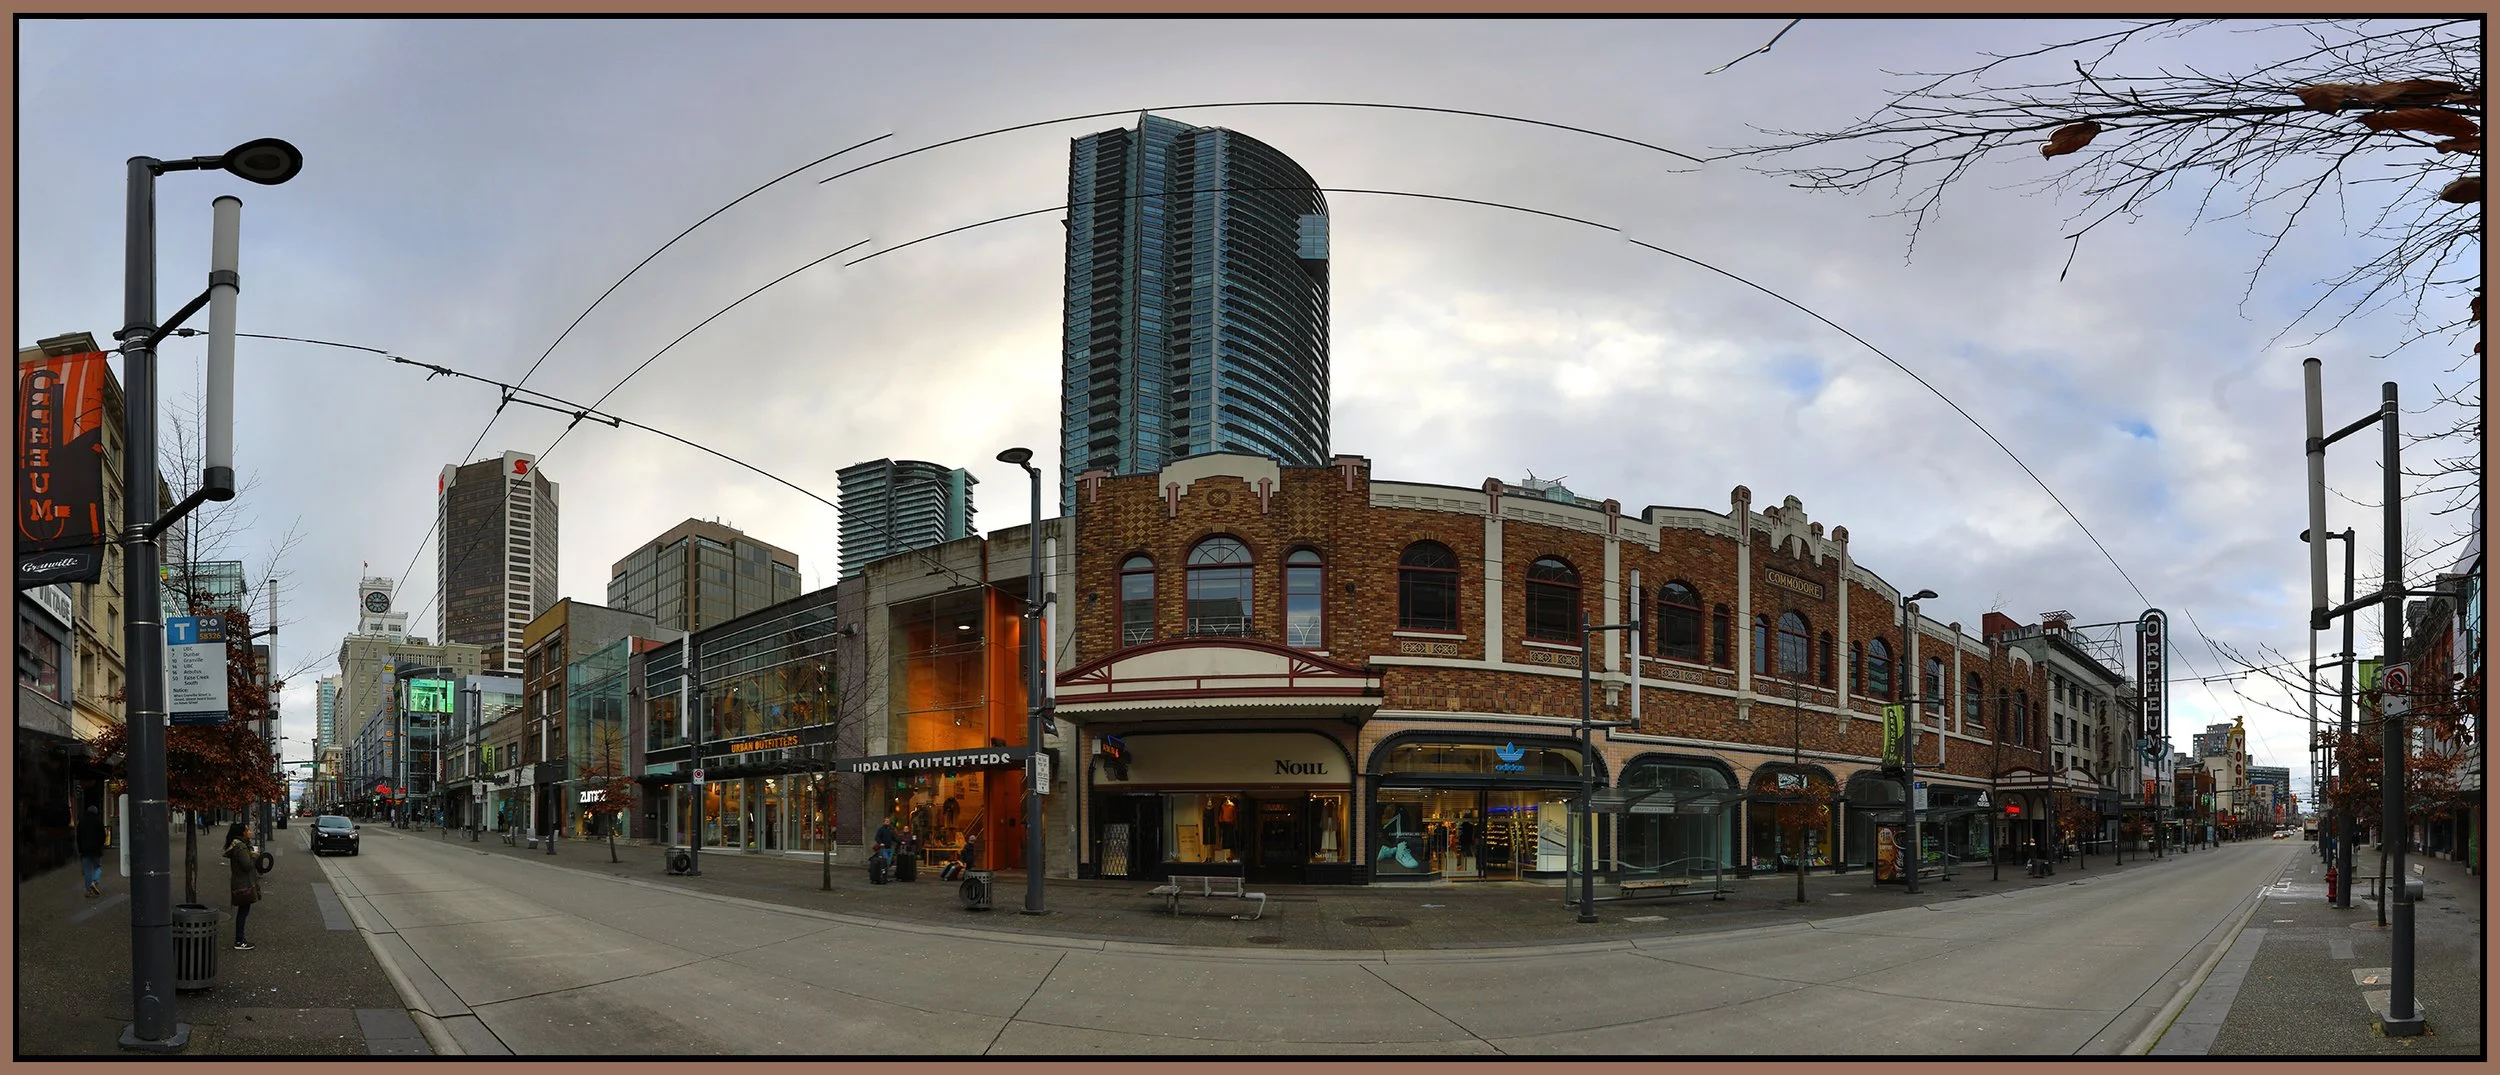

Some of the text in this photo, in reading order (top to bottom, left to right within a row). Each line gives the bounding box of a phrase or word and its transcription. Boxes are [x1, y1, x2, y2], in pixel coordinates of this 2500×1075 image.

[29, 375, 54, 522] ORPHEUM
[22, 558, 78, 573] Granville
[1768, 571, 1820, 597] COMMODORE
[174, 622, 190, 640] T
[199, 632, 221, 640] 58326
[2146, 621, 2162, 750] ORPHEUM
[731, 735, 798, 753] URBAN OUTFITTERS
[1495, 763, 1526, 772] adidas
